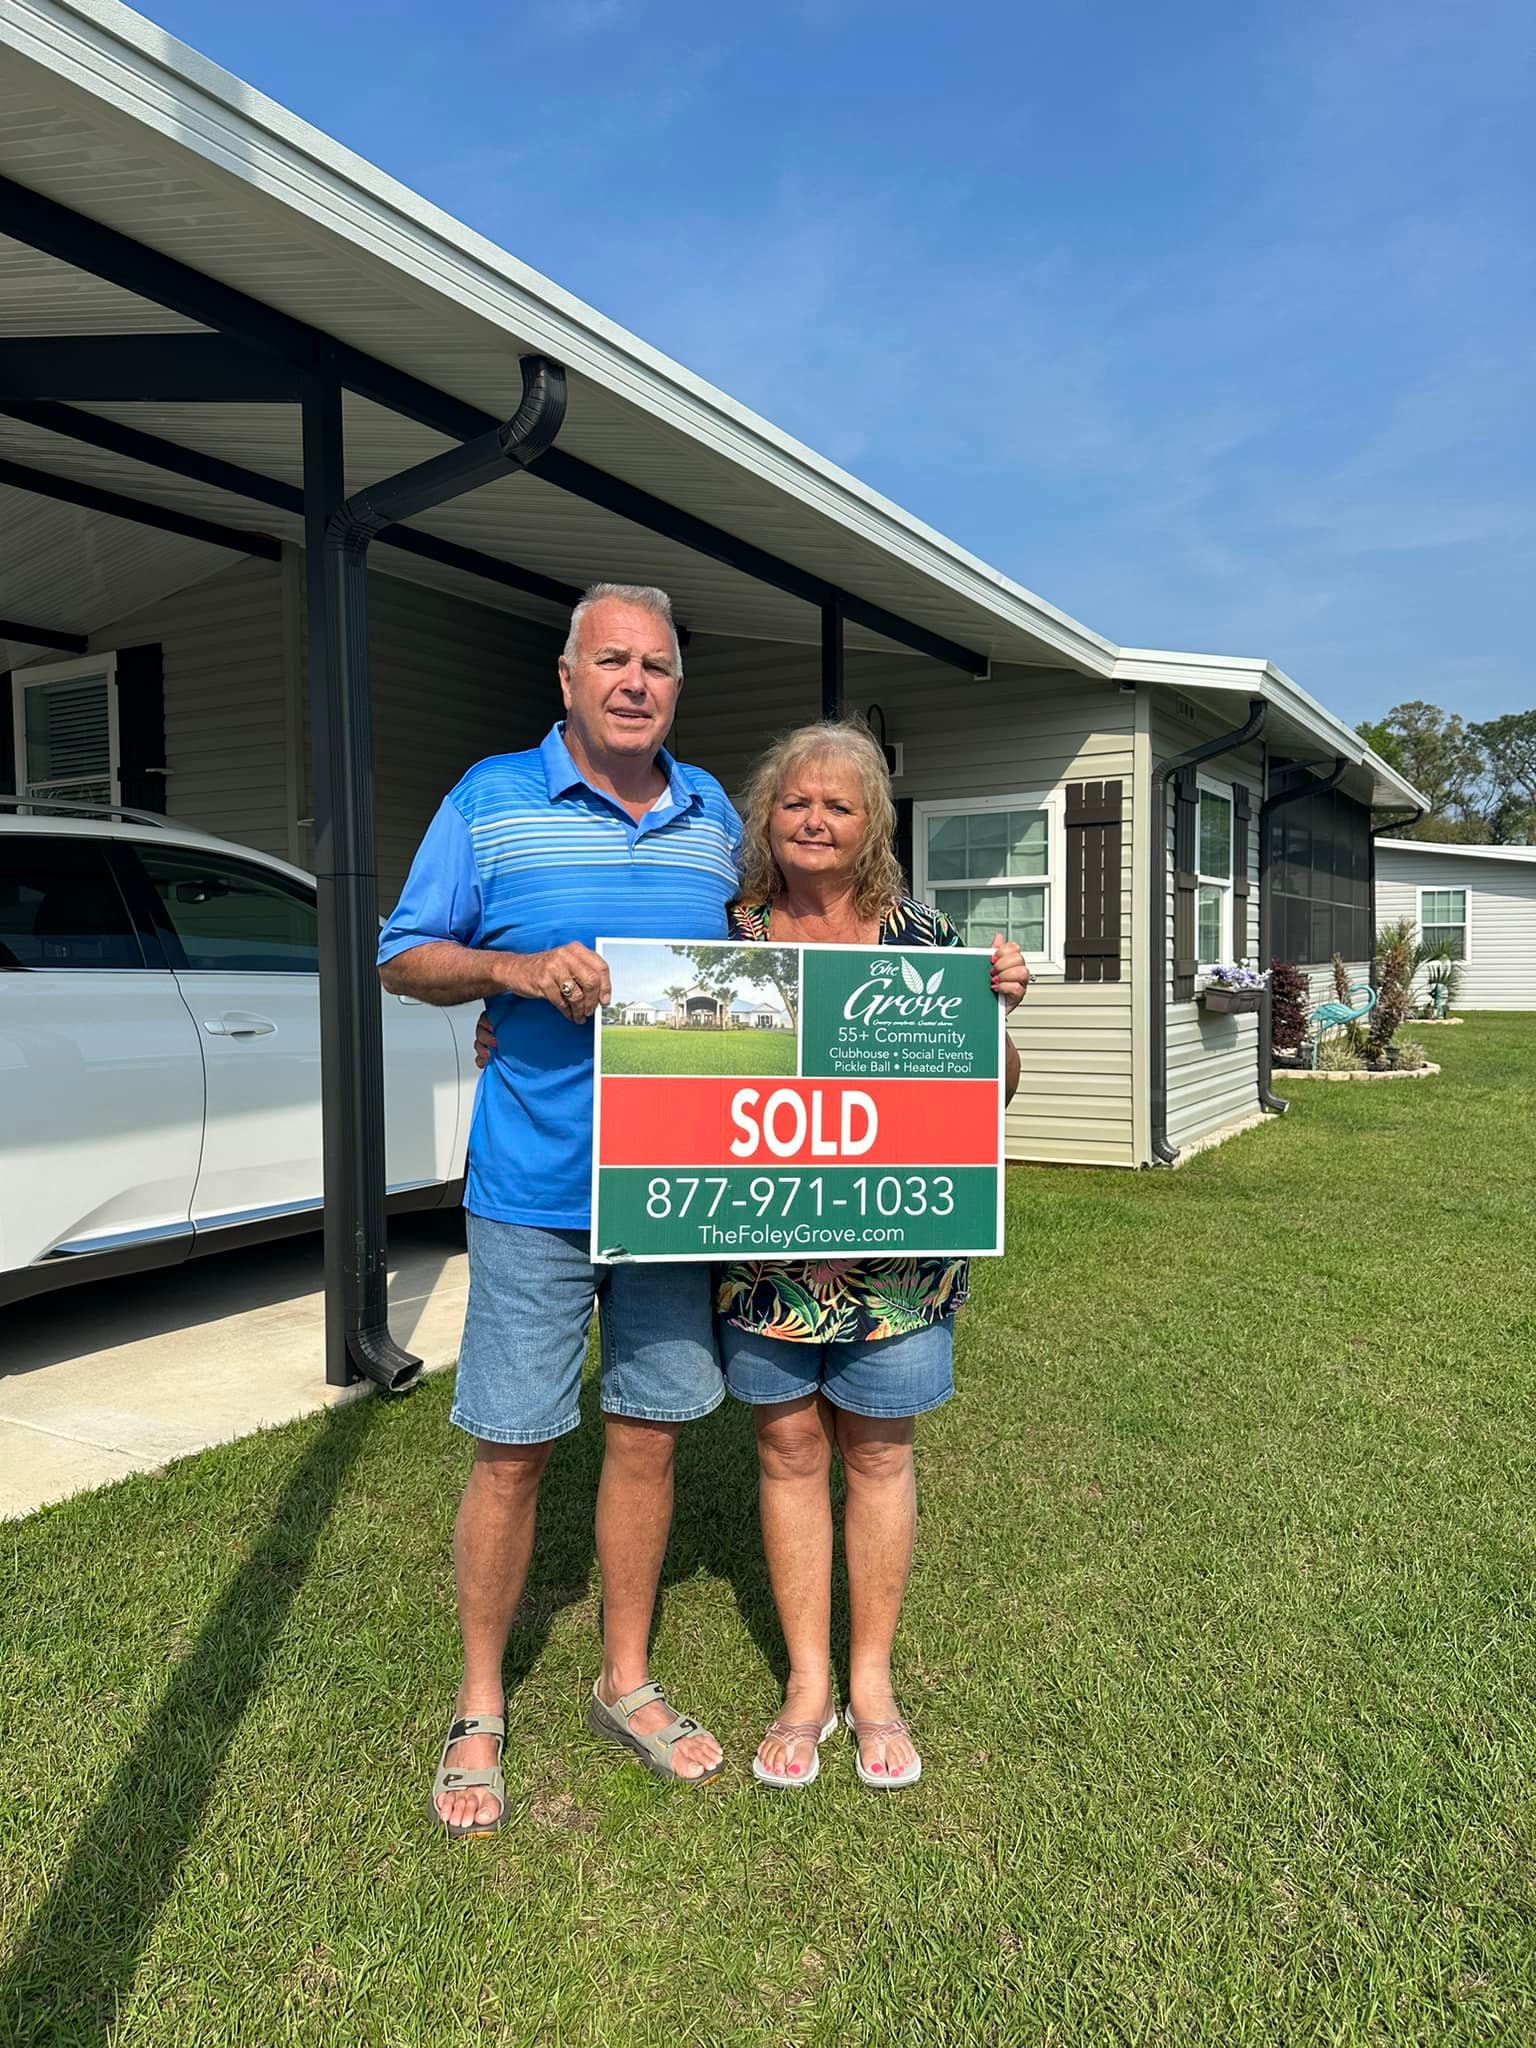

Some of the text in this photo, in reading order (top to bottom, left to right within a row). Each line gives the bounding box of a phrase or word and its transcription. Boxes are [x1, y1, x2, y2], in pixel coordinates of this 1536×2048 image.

[870, 959, 900, 976] The
[843, 978, 963, 1026] Grove
[838, 1027, 966, 1048] 55+ Community
[829, 1047, 974, 1061] Clubhouse Social Events
[834, 1060, 972, 1073] Pickle Ball Heated Pool
[729, 1088, 879, 1158] SOLD
[646, 1176, 954, 1218] 877-971-1033
[698, 1223, 905, 1249] TheFoleyGrove.com
